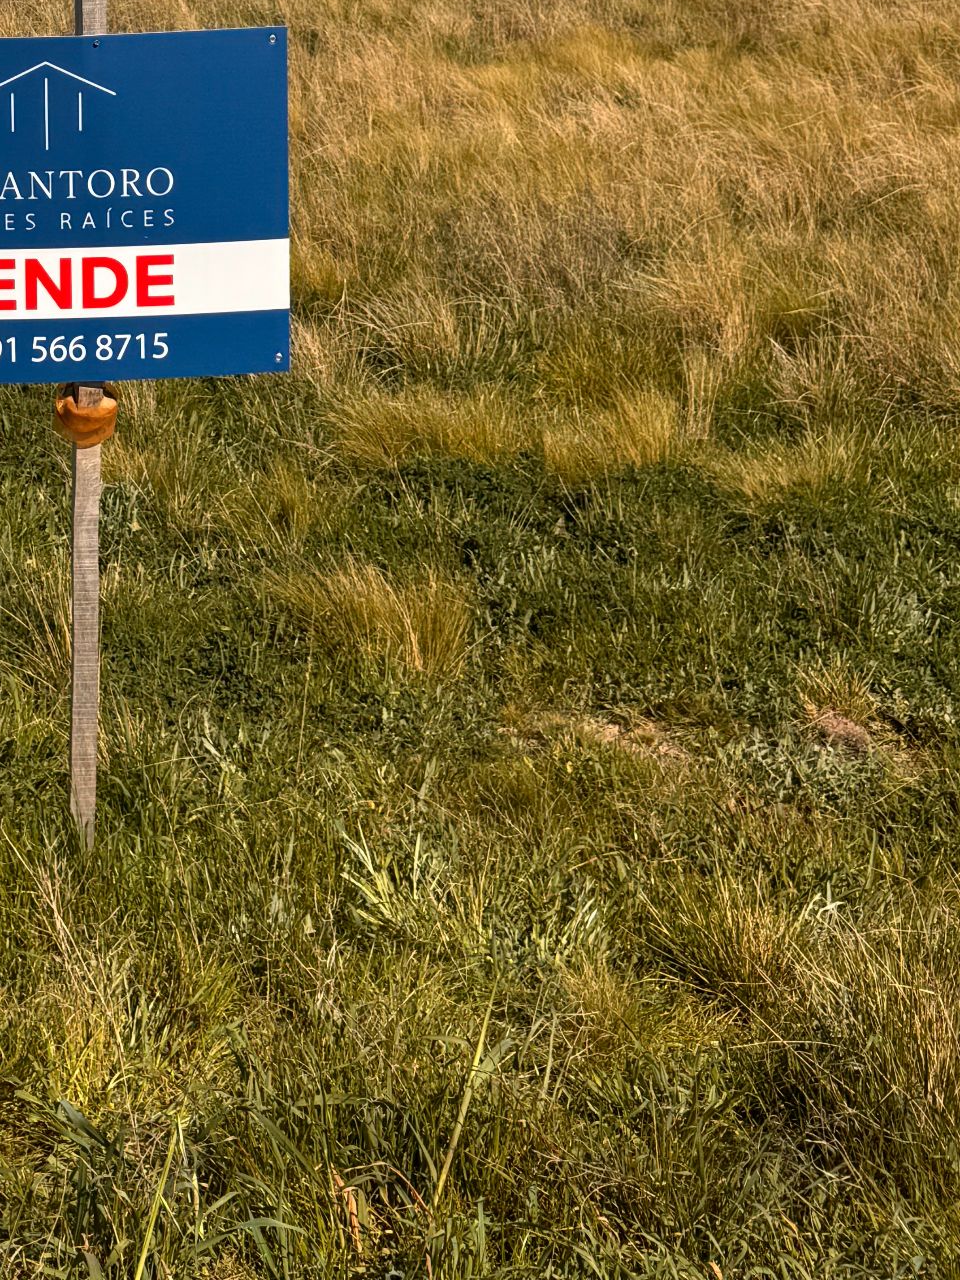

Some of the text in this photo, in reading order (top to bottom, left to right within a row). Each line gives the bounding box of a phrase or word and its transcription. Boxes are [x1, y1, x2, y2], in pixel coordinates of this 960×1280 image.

[60, 207, 176, 230] RAÍCES
[31, 334, 86, 362] 566
[95, 332, 169, 360] 8715
